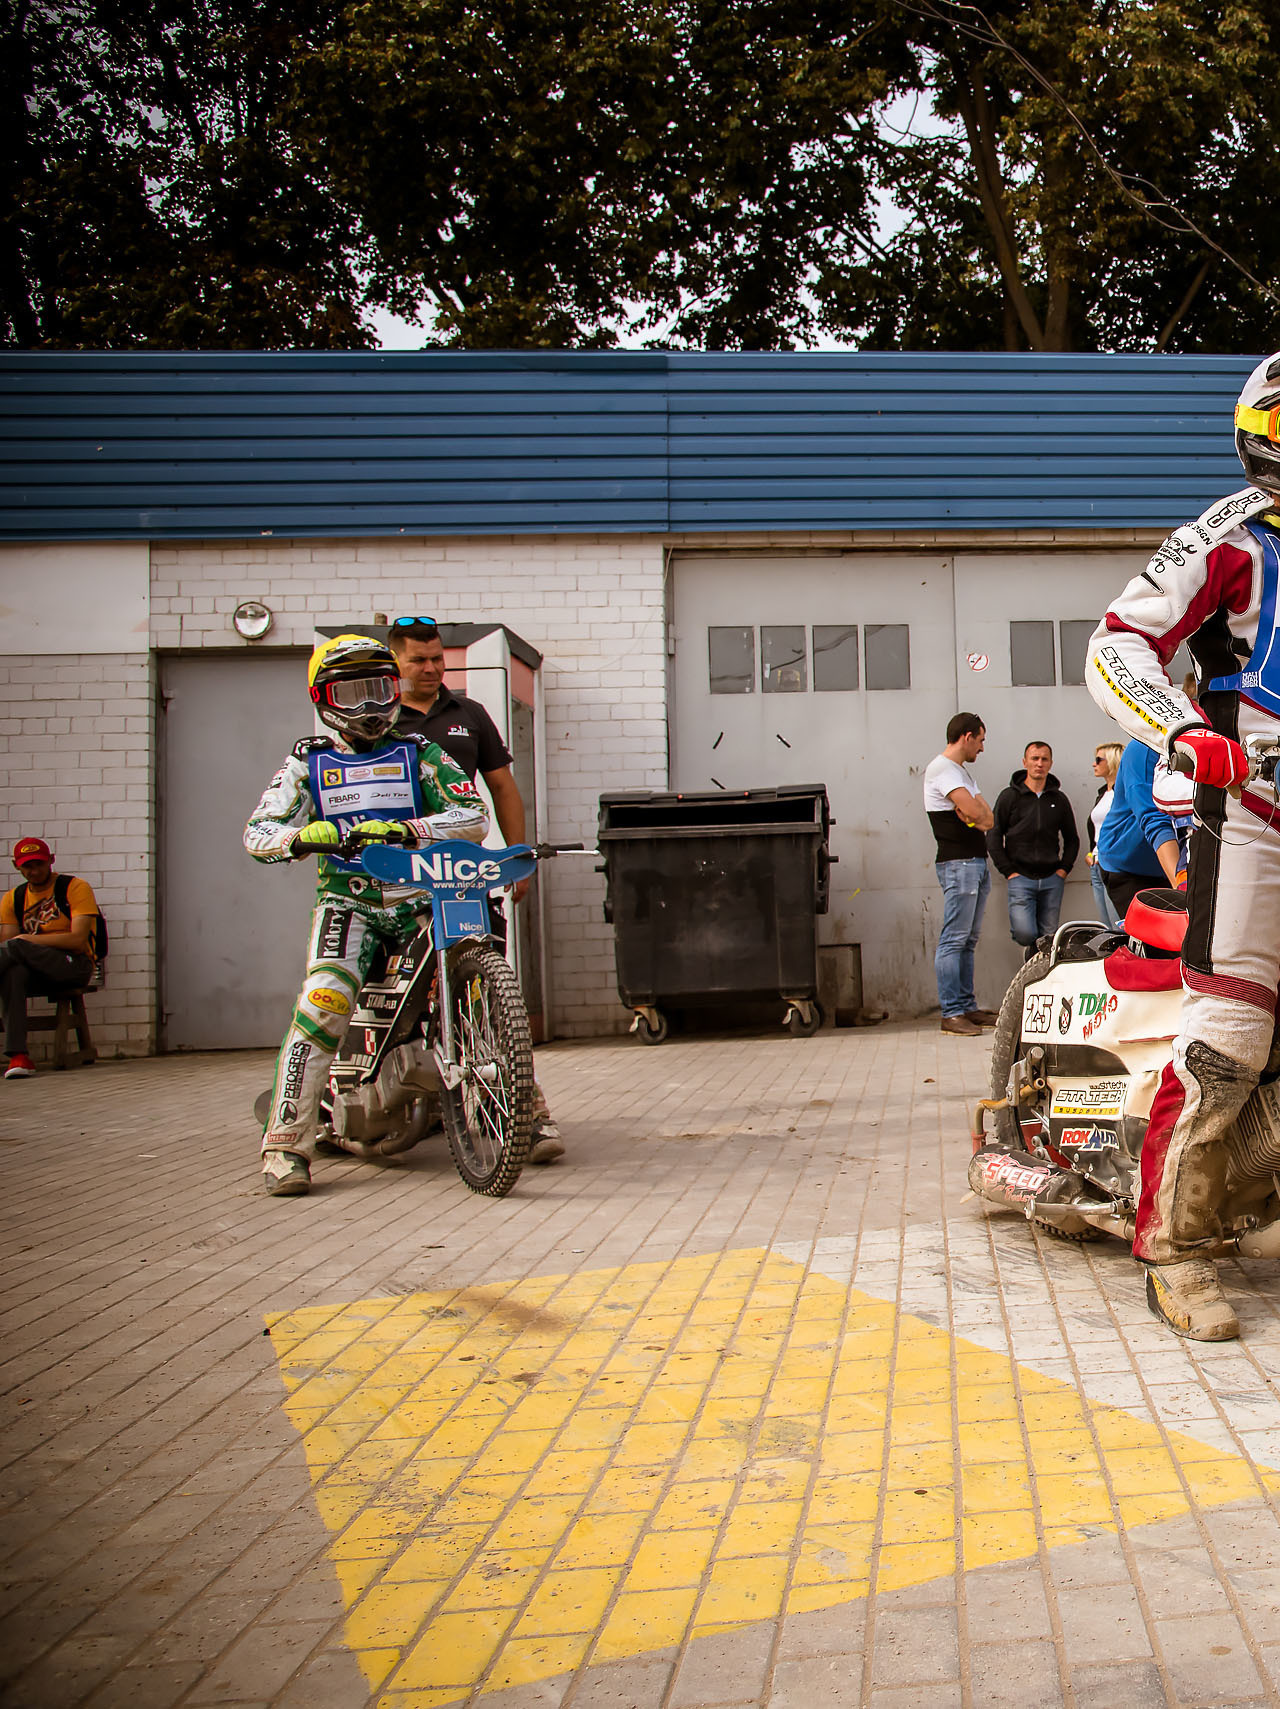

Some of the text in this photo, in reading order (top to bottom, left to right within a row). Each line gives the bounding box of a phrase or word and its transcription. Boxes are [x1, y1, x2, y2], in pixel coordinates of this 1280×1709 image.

[1096, 662, 1163, 731] suspension
[328, 793, 360, 805] FIBARO
[411, 852, 501, 882] Nice
[432, 880, 486, 890] www.nice.pl
[322, 911, 345, 957] Kolory
[459, 921, 483, 932] Nice
[1024, 994, 1054, 1034] 25
[284, 1041, 305, 1098] PROGRES
[984, 1162, 1046, 1192] SPEED
